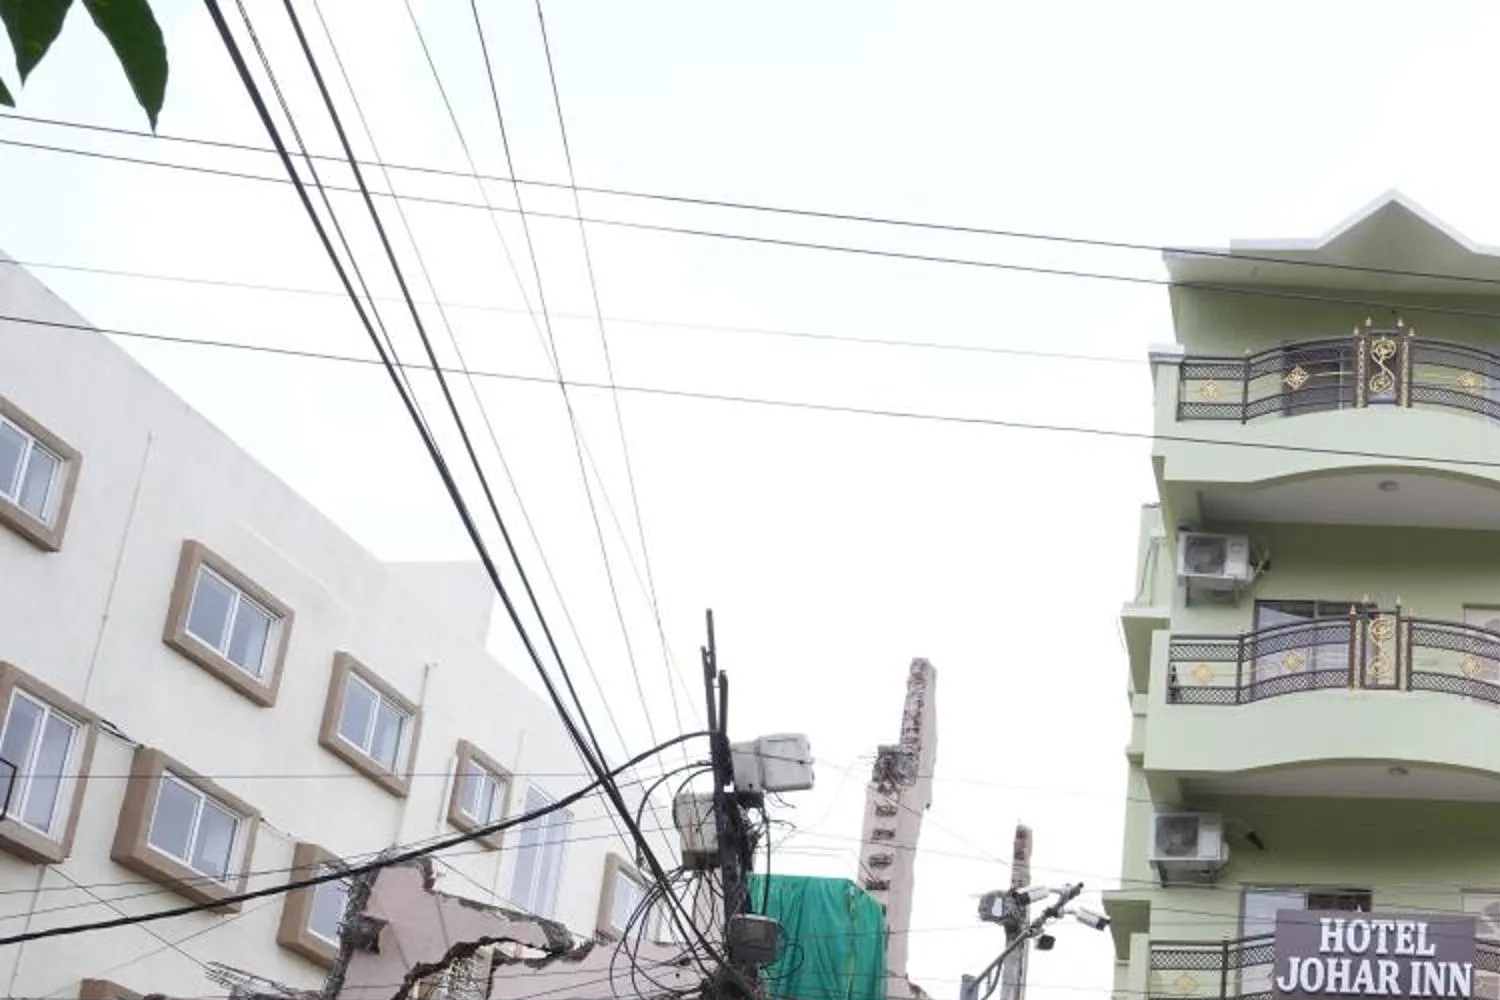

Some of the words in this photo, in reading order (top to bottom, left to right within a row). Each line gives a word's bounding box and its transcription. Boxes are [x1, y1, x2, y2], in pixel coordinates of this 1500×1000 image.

[1319, 917, 1435, 957] HOTEL
[1276, 957, 1402, 996] JOHAR
[1409, 961, 1473, 998] INN
